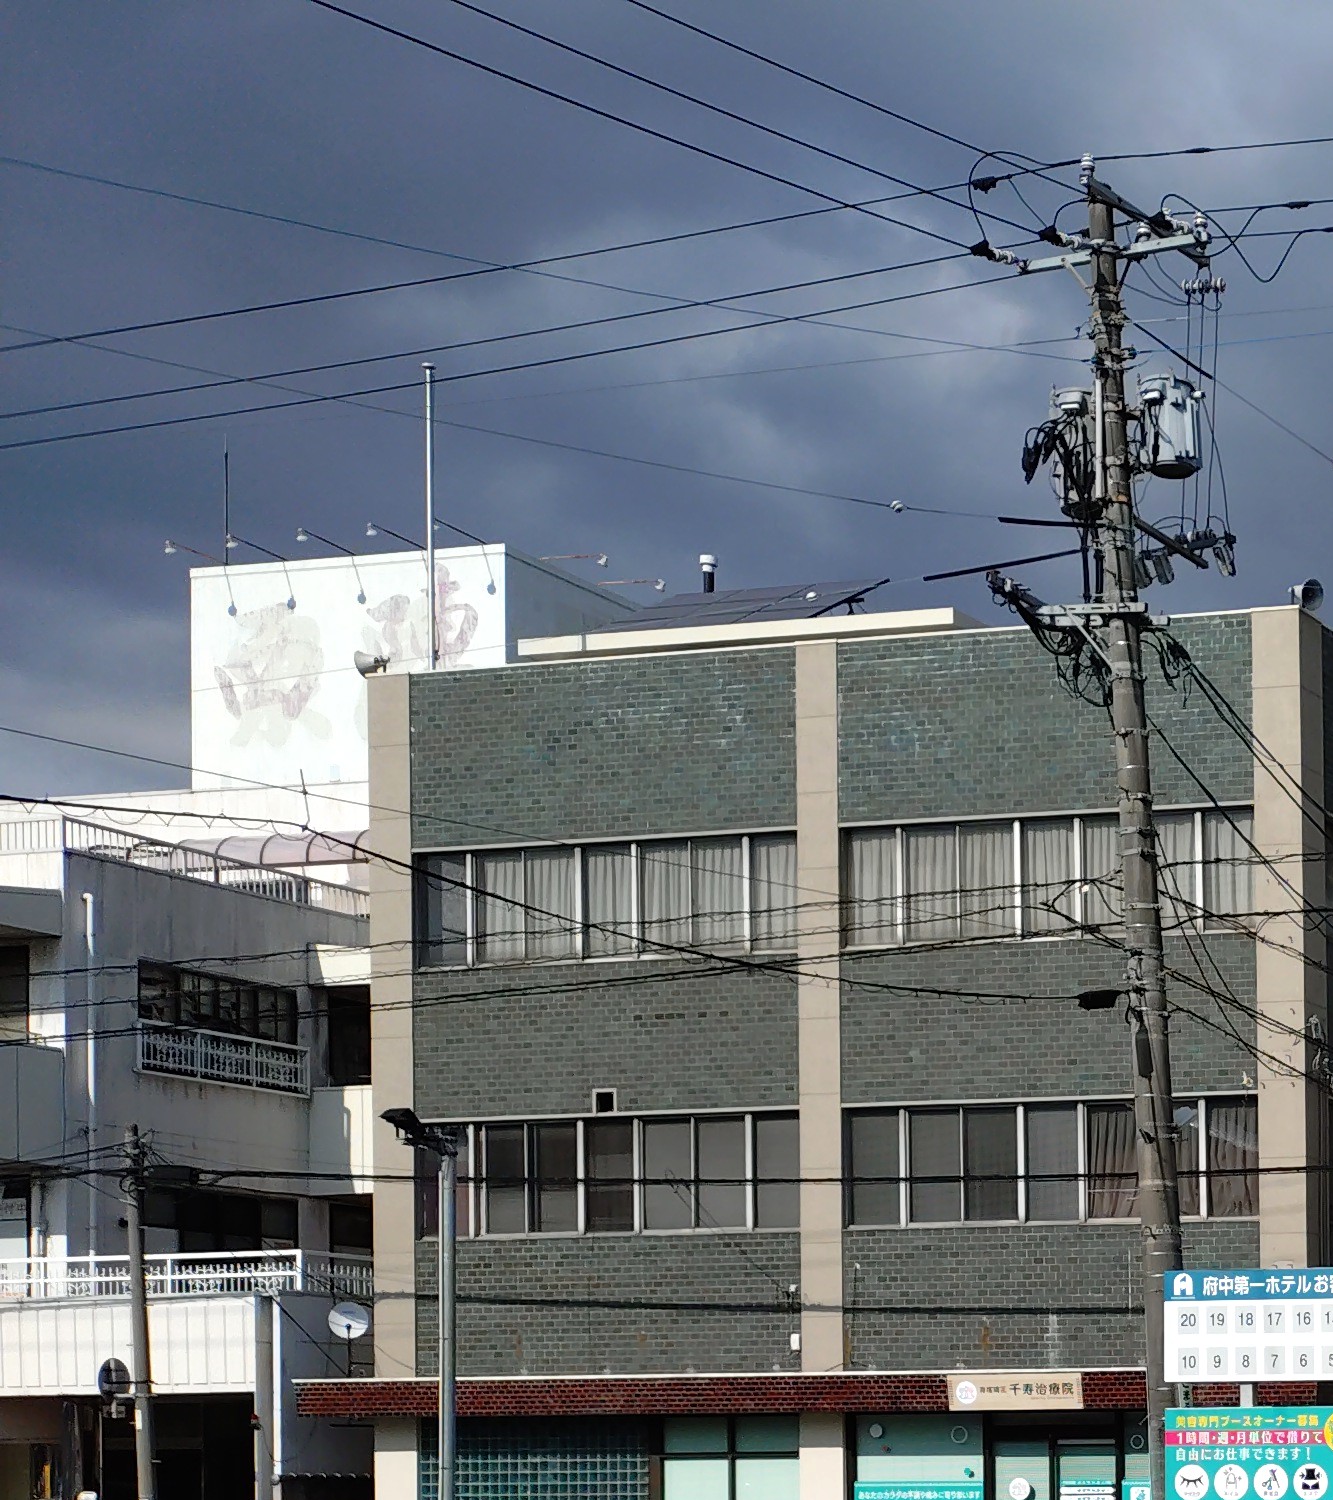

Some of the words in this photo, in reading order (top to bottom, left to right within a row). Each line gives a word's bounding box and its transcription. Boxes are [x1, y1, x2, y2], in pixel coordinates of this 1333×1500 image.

[1180, 1313, 1197, 1327] 20
[1209, 1312, 1225, 1327] 19
[1238, 1312, 1254, 1326] 18
[1267, 1312, 1283, 1326] 17
[1296, 1311, 1311, 1326] 16
[1182, 1355, 1197, 1370] 10
[1213, 1354, 1222, 1369] 9
[1241, 1354, 1250, 1368] 8
[1271, 1354, 1279, 1368] 7
[1299, 1353, 1308, 1368] 6
